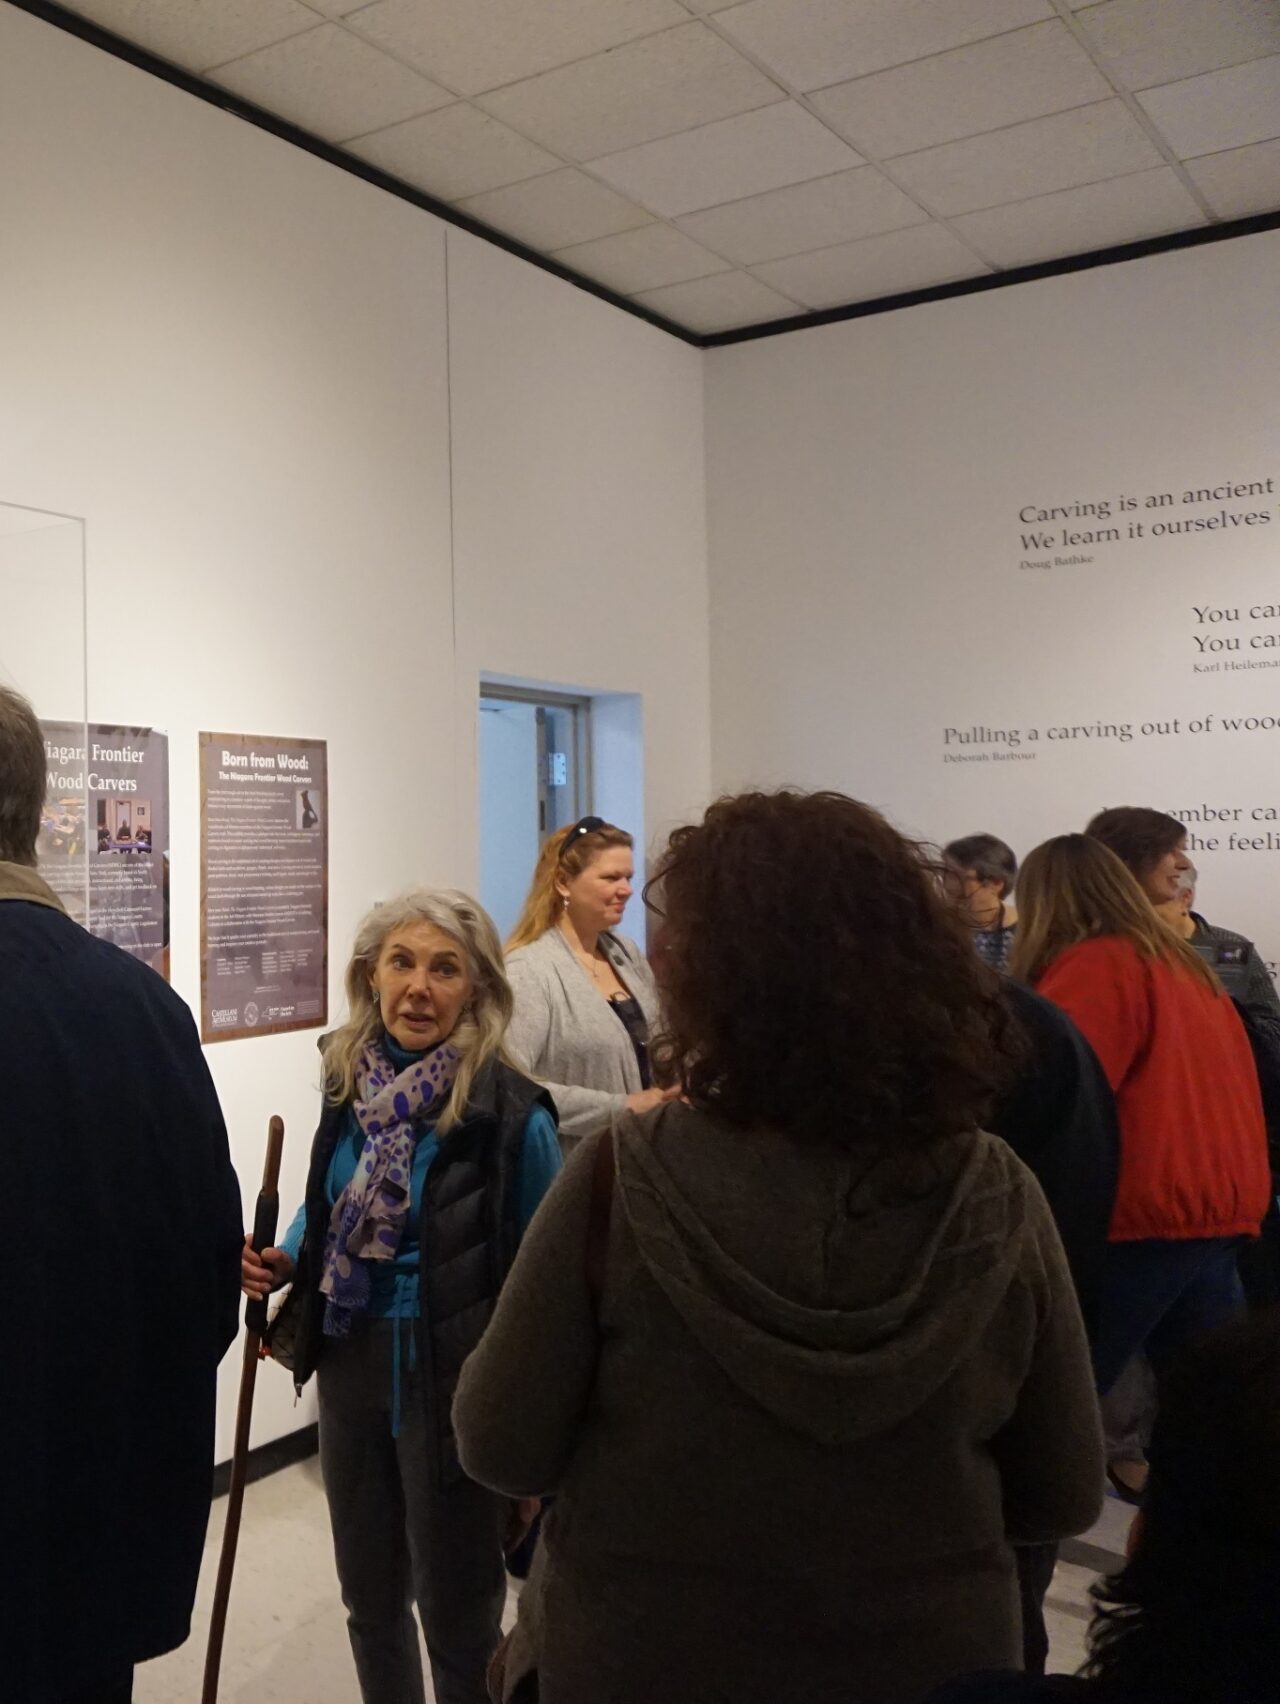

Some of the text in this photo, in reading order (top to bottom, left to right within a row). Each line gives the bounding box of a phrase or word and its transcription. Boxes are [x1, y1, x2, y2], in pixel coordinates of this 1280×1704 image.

[1019, 478, 1274, 524] Carving is an ancient
[1020, 510, 1271, 551] We learn it ourselves
[1192, 604, 1280, 624] You ca
[1192, 634, 1280, 653] You ca
[1193, 662, 1220, 673] Karl
[943, 714, 1280, 747] Pulling a carving out of woo
[45, 741, 144, 765] iagara Frontier
[221, 750, 309, 770] Born from Wood:
[46, 771, 137, 791] Wood Carvers
[218, 771, 230, 781] The
[276, 774, 292, 784] Wood
[1184, 833, 1219, 850] he
